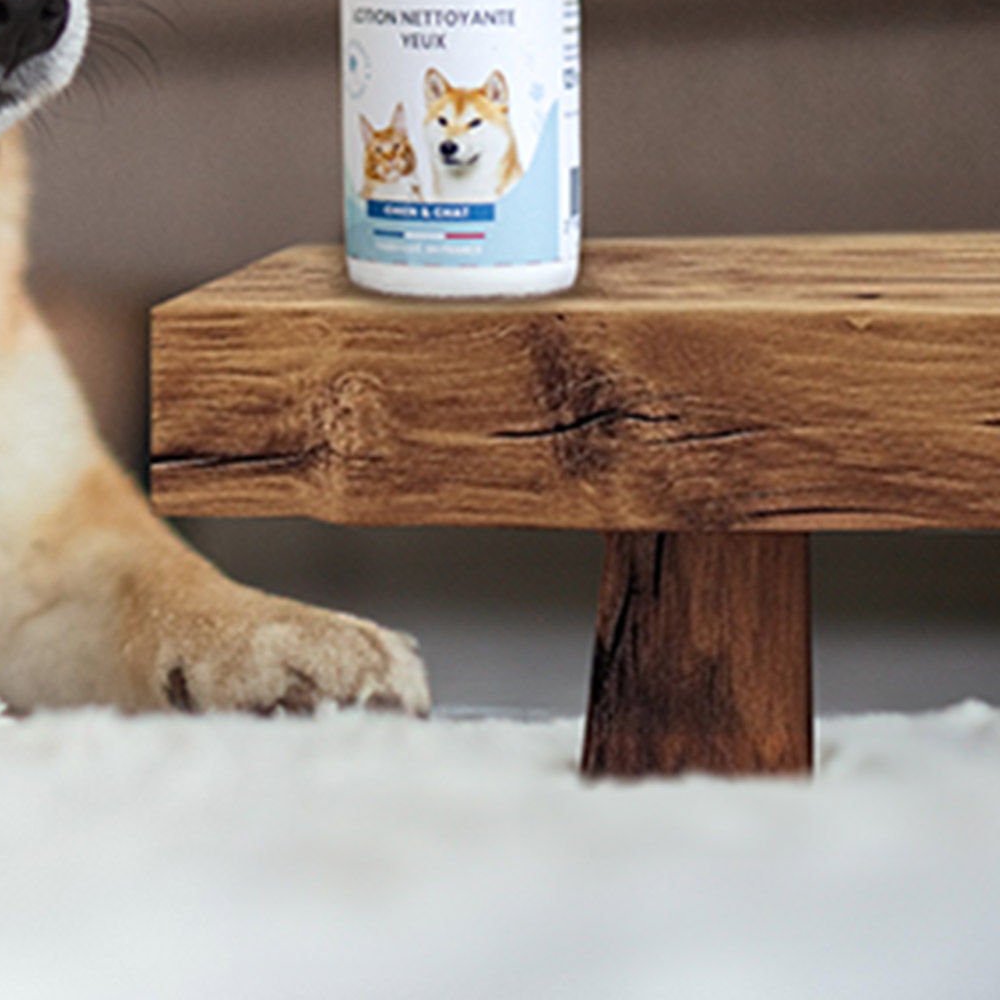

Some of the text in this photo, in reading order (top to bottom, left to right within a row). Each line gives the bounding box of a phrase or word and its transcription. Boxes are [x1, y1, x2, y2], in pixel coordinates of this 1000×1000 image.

[353, 8, 516, 26] OTION NETTOYANTE
[401, 33, 446, 50] YEUX
[433, 207, 470, 219] CHAT
